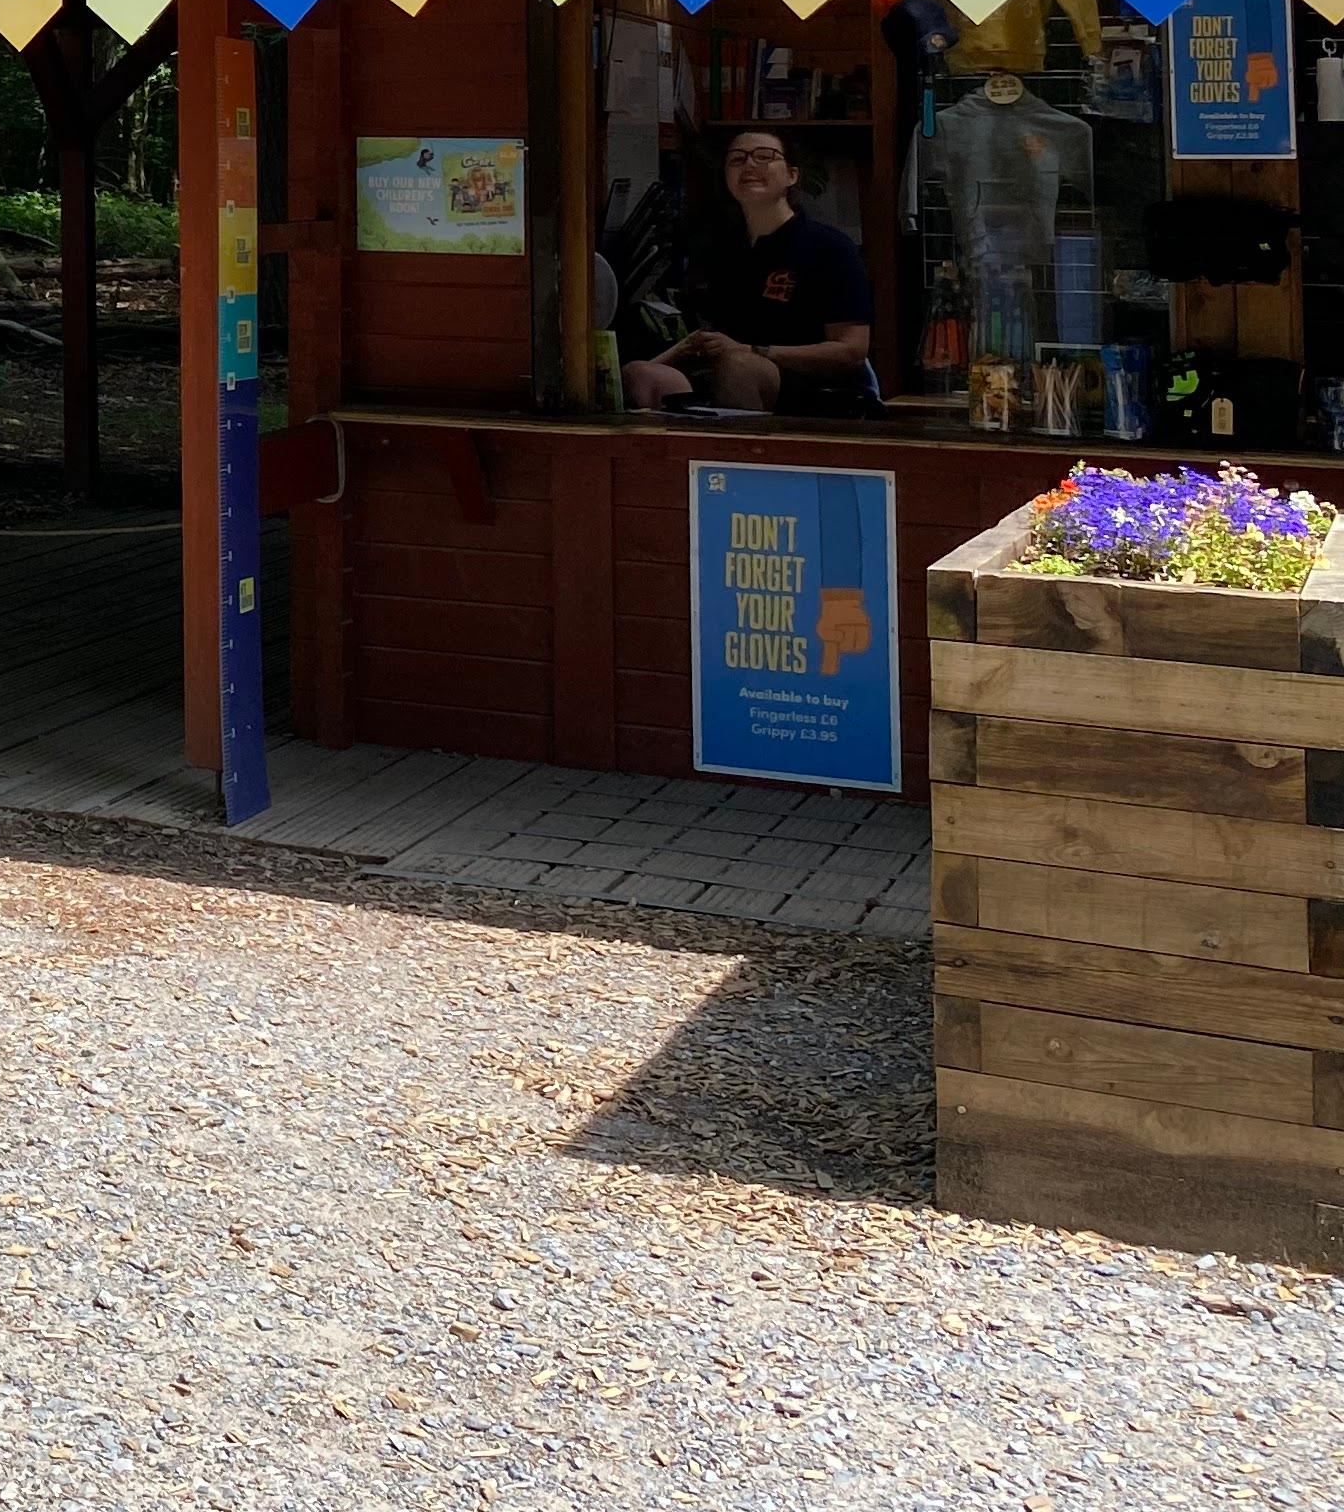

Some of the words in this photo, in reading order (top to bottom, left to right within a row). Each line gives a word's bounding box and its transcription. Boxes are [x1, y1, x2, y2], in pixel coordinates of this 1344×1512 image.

[1192, 16, 1233, 36] DON'T
[1190, 38, 1238, 59] FORGET
[1197, 61, 1232, 81] YOUR
[1190, 82, 1240, 103] GLOVES
[368, 177, 389, 188] BUY
[393, 177, 414, 188] OUR
[418, 177, 441, 189] NEW
[376, 189, 434, 202] CHILDREN'S
[731, 513, 797, 553] DON'T
[725, 552, 806, 593] FORGET
[736, 592, 794, 633] YOUR
[725, 631, 807, 674] GLOVES
[739, 687, 802, 704] Available
[806, 694, 820, 706] to
[823, 695, 849, 710] buy
[750, 706, 817, 727] Fingerless
[751, 724, 796, 740] Grippy
[800, 728, 838, 743] £3.95
